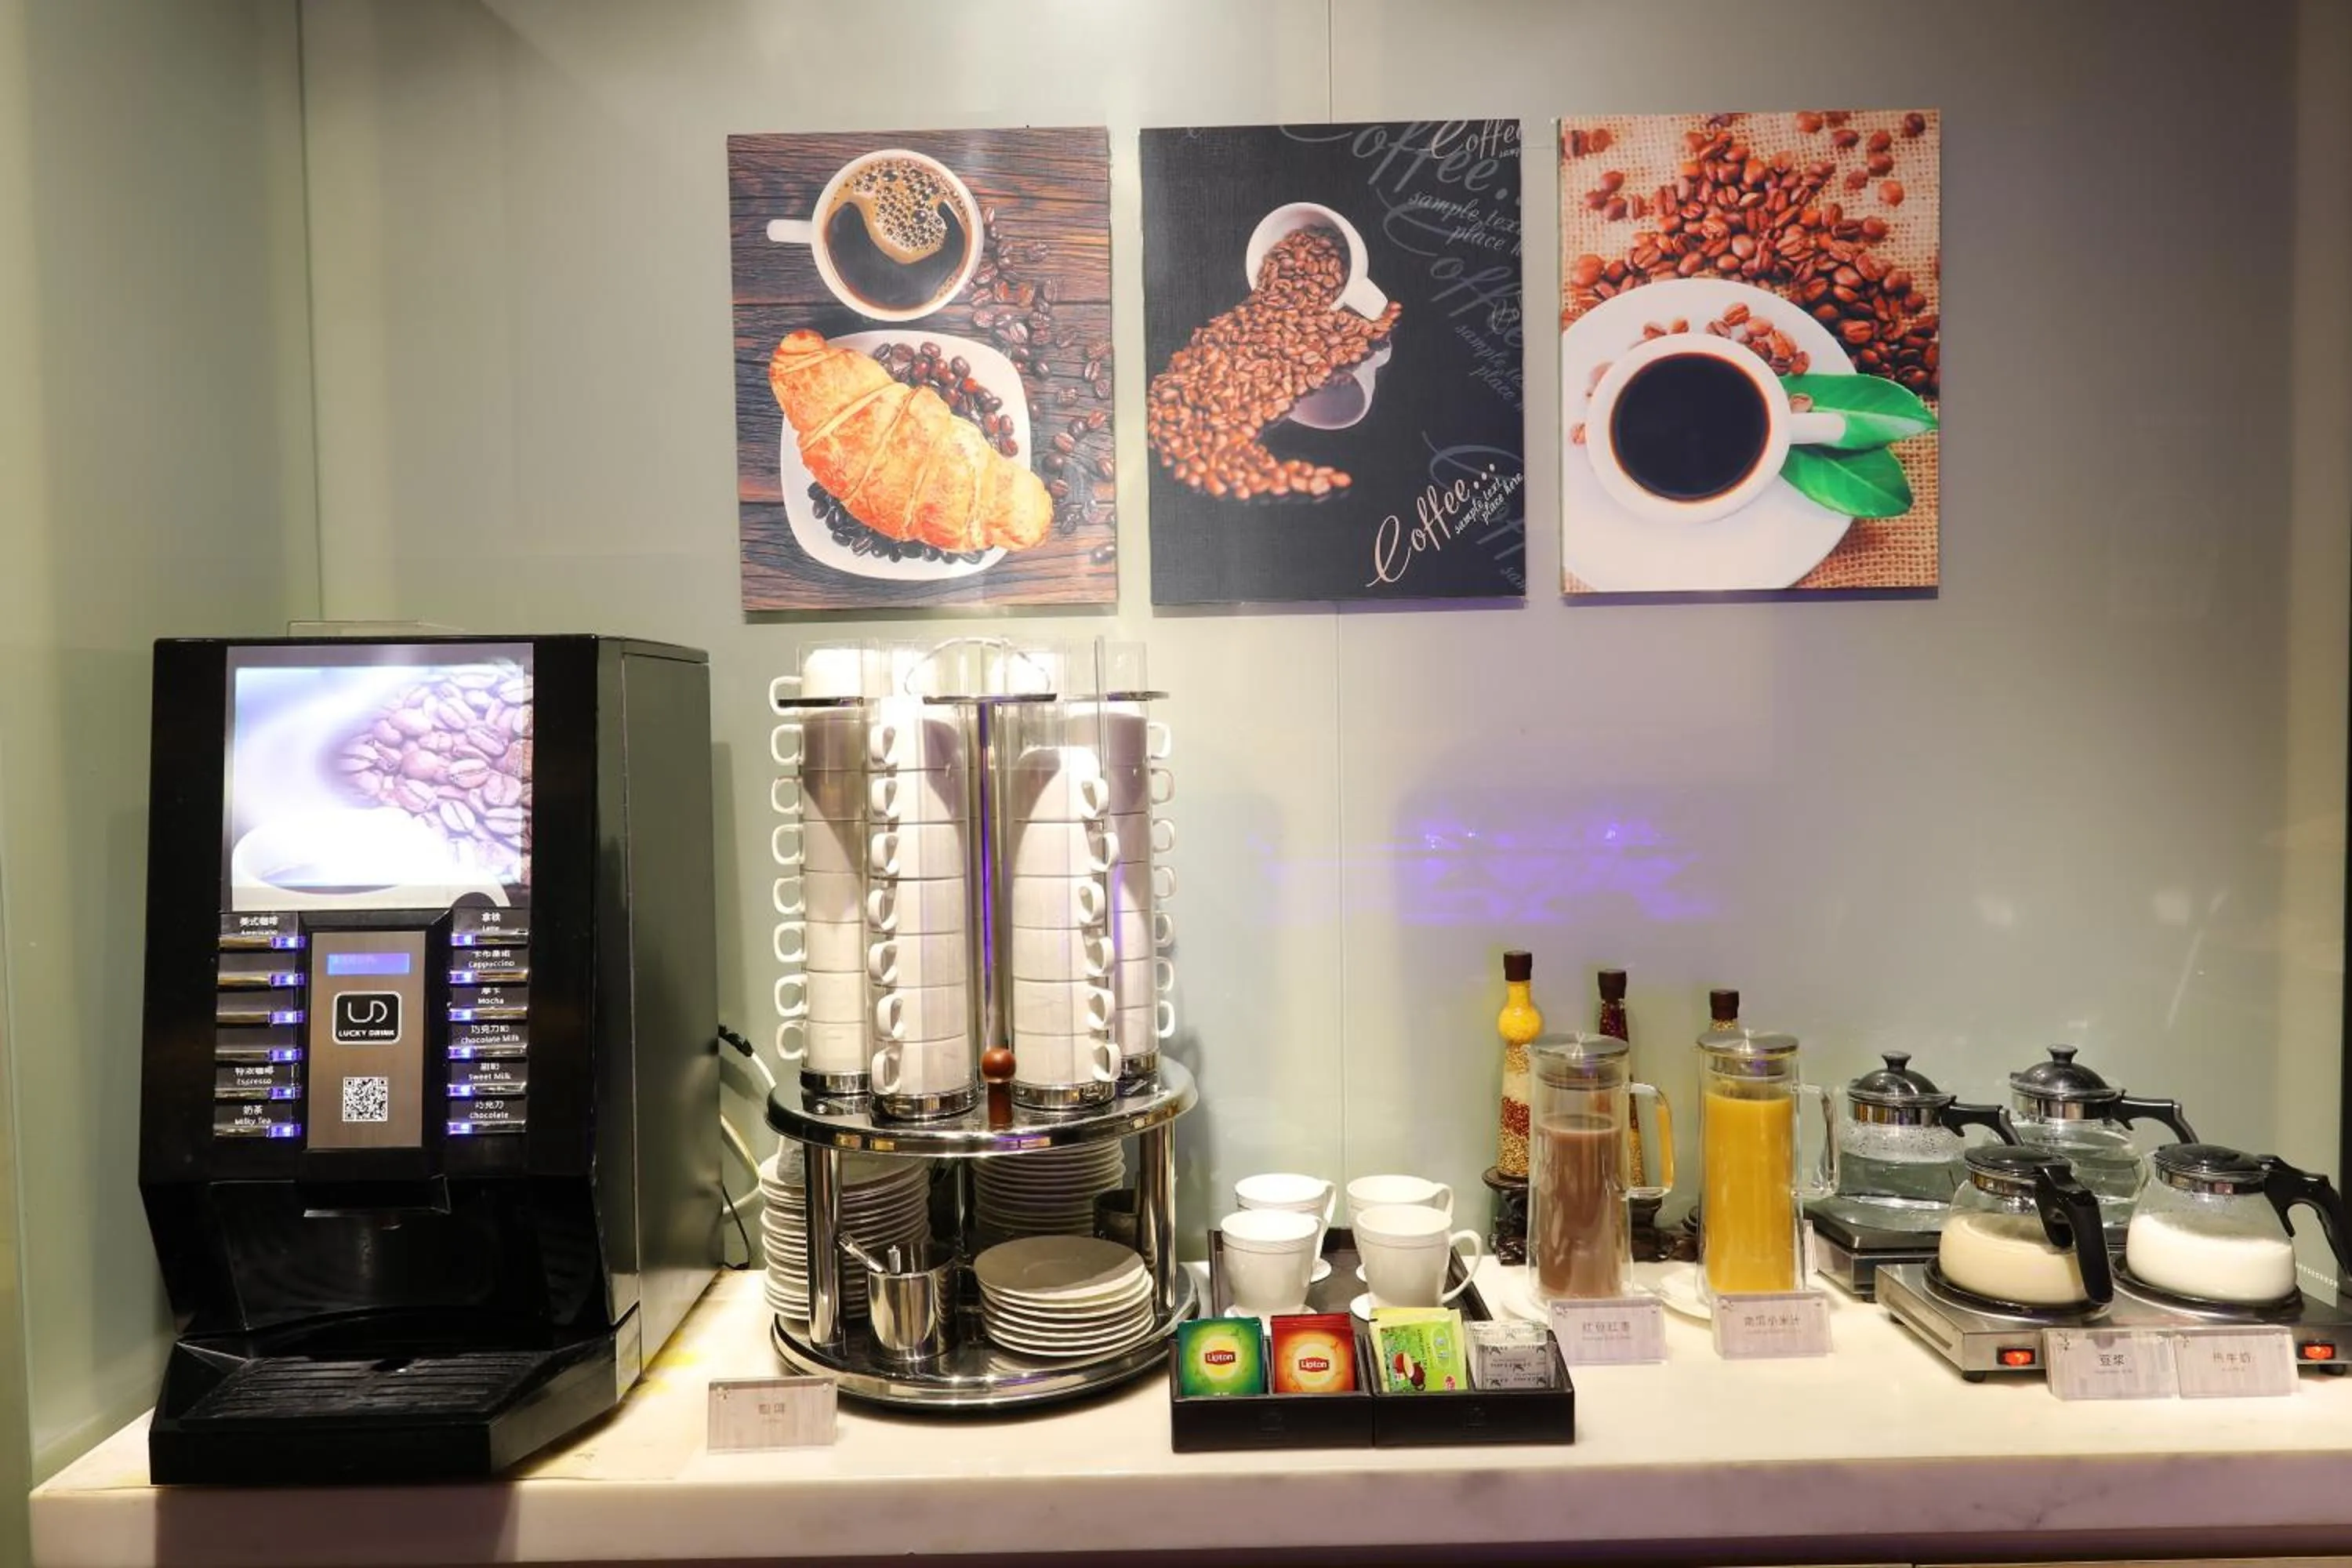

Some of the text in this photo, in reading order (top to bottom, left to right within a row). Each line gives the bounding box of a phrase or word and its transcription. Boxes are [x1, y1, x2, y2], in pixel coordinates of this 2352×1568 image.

[1207, 1353, 1234, 1363] Lipton
[2099, 1354, 2125, 1366] 豆浆
[1300, 1360, 1328, 1370] Lipton
